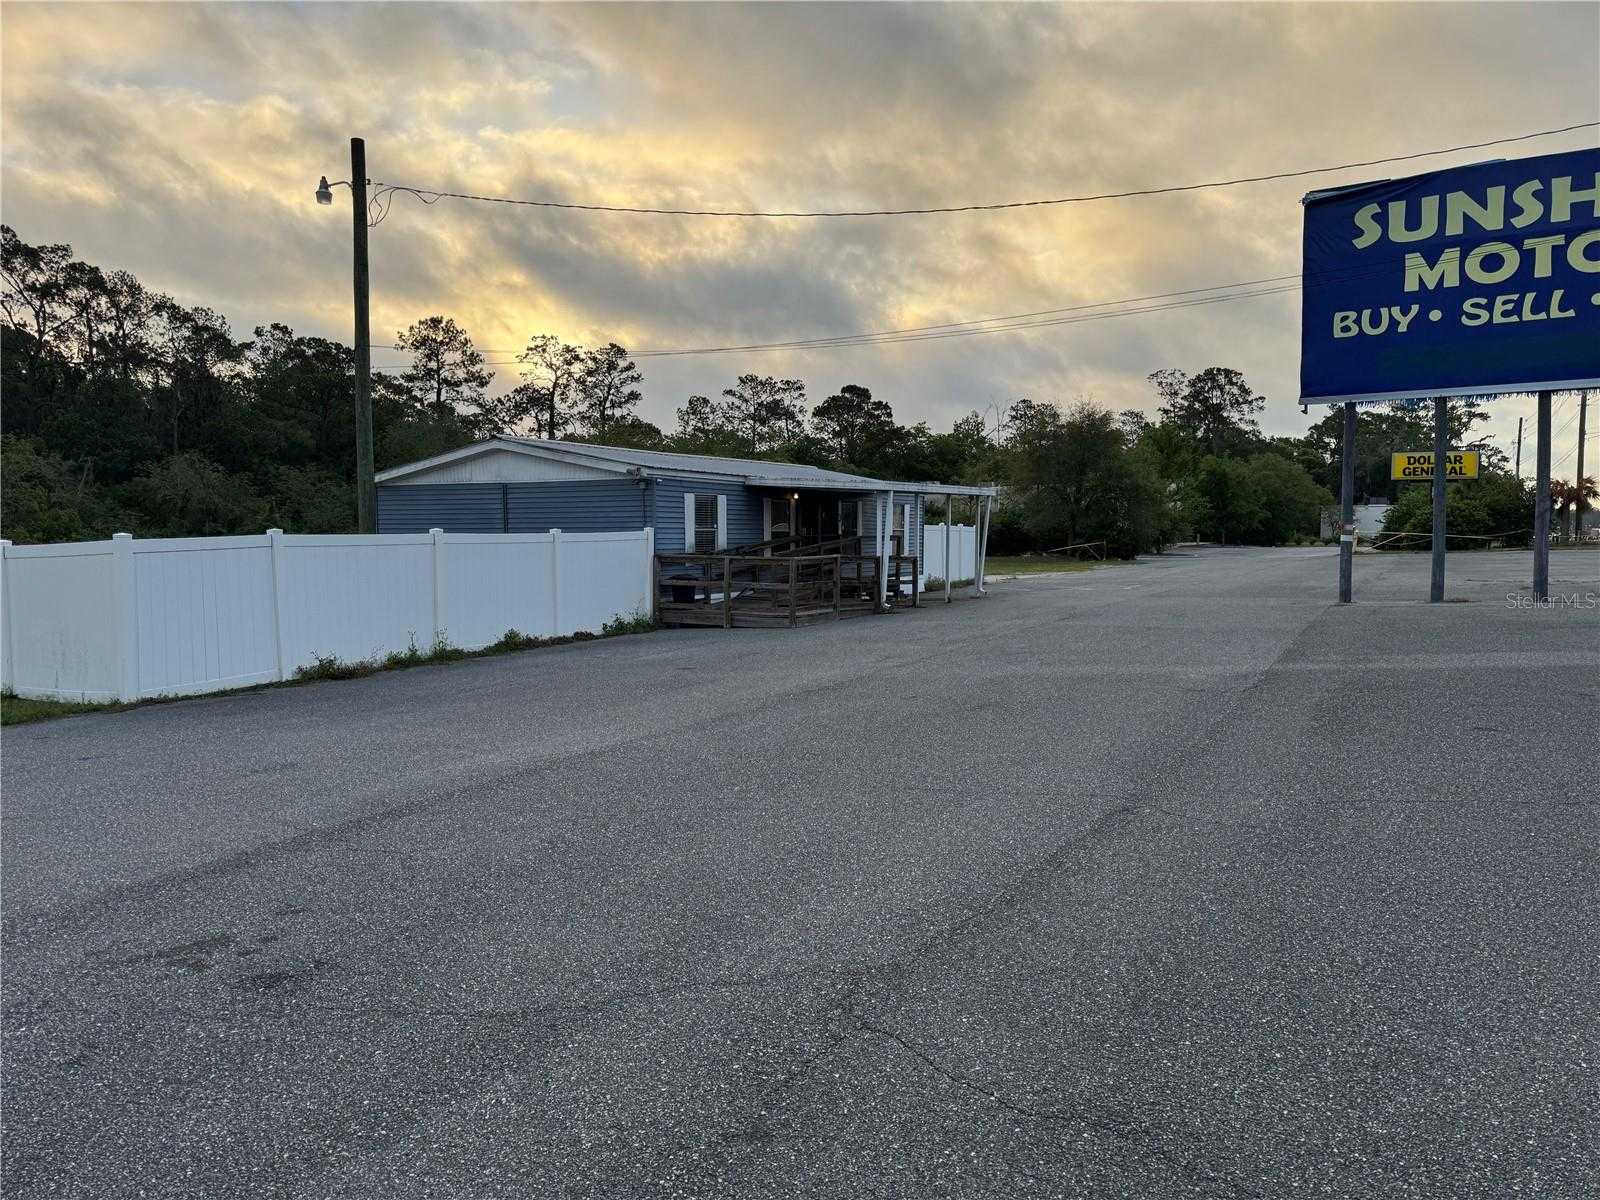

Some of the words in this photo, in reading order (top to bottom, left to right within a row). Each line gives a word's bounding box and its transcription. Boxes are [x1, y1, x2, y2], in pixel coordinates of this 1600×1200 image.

[1352, 172, 1600, 249] SUNSH
[1404, 229, 1600, 292] MOTO
[1333, 305, 1419, 338] BUY
[1461, 289, 1576, 326] SELL
[1402, 466, 1466, 476] GENAL
[1407, 455, 1463, 465] DOLAR
